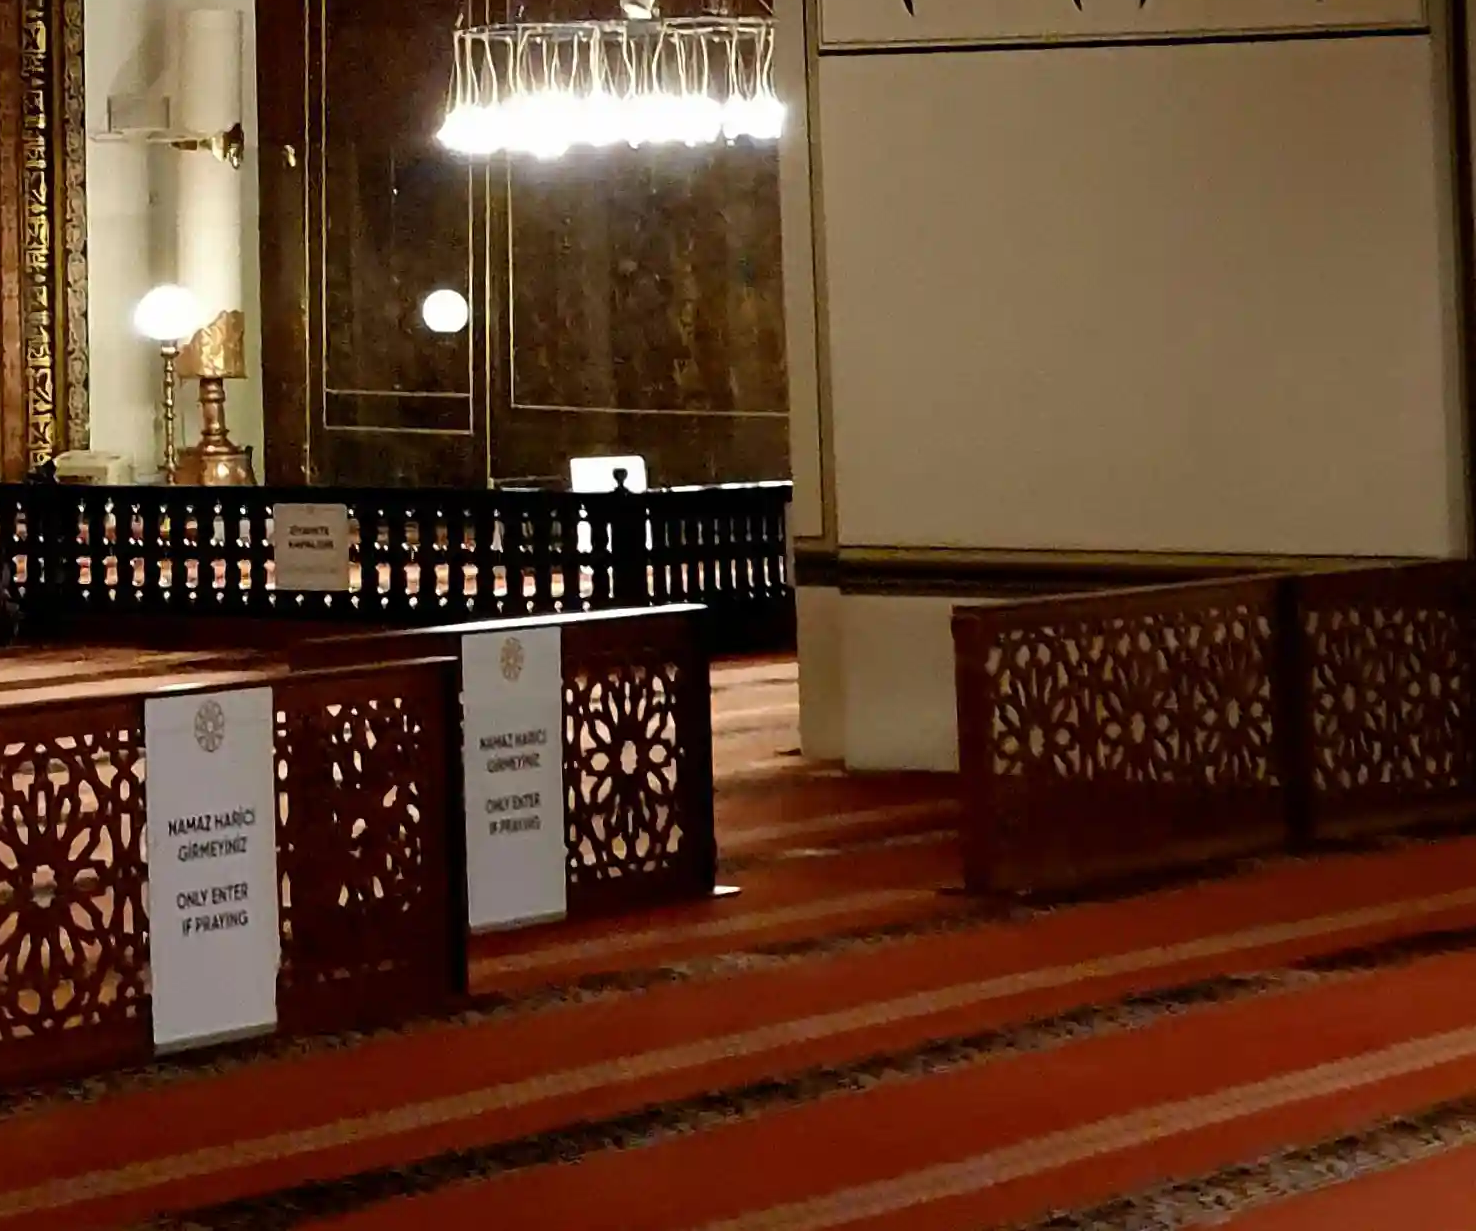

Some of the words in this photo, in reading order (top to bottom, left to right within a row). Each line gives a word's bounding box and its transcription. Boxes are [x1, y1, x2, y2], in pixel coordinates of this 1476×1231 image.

[168, 814, 211, 836] NAMAZ
[176, 889, 208, 910] ONLY
[212, 881, 248, 905] ENTER
[182, 917, 192, 936] IF
[195, 909, 248, 932] PRAYING
